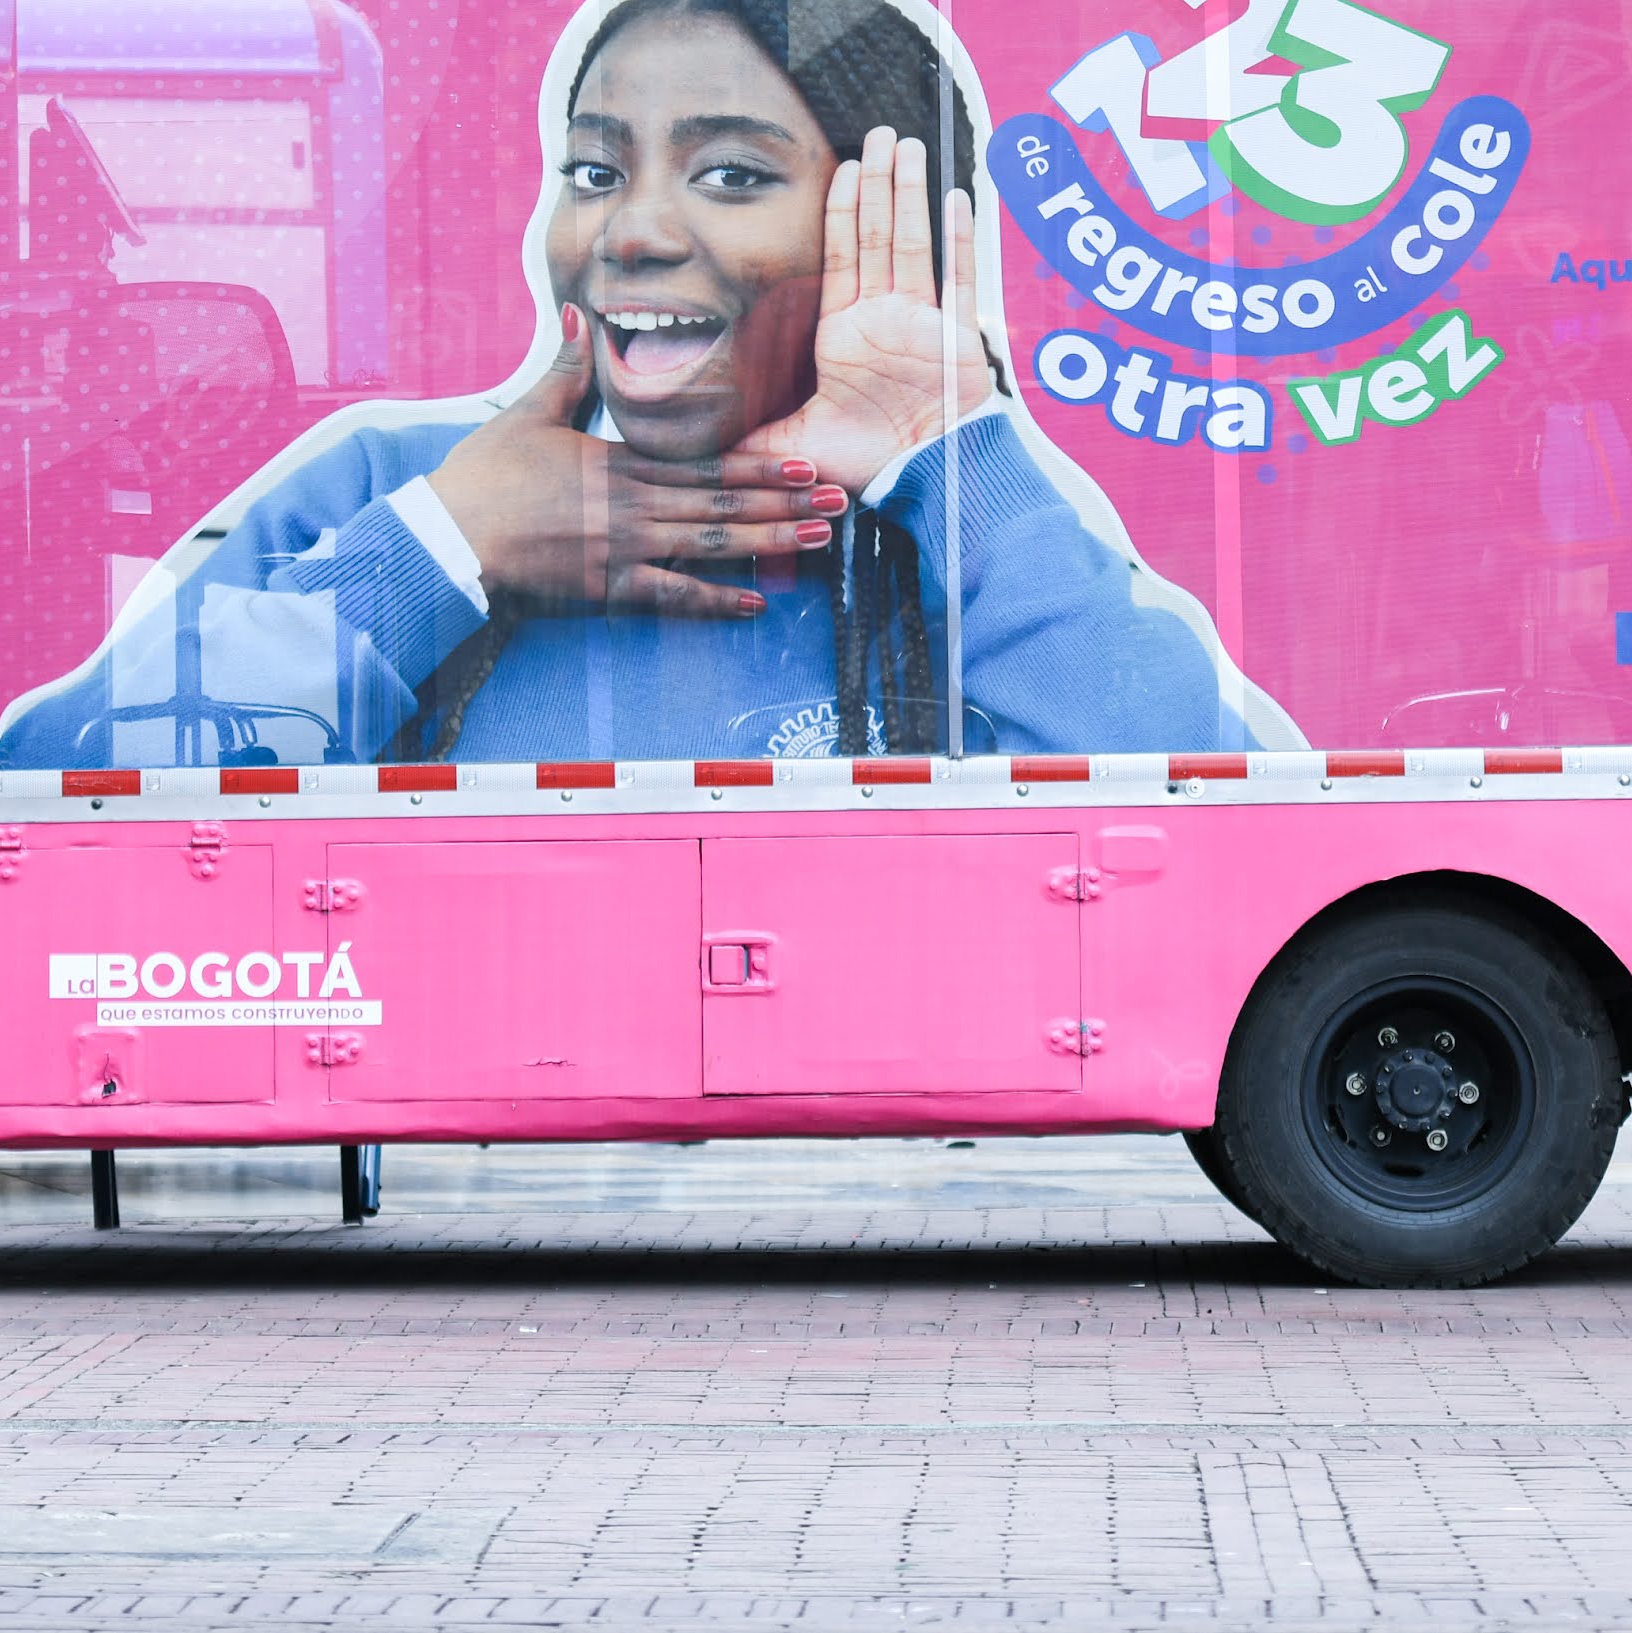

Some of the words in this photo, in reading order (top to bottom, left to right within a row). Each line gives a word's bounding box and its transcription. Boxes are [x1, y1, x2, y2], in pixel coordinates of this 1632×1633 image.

[1016, 134, 1050, 179] de
[1036, 181, 1336, 334] regreso
[1352, 266, 1388, 305] al
[1389, 122, 1512, 276] cole
[1296, 316, 1498, 442] vez
[97, 940, 363, 999] BOGOTÁ
